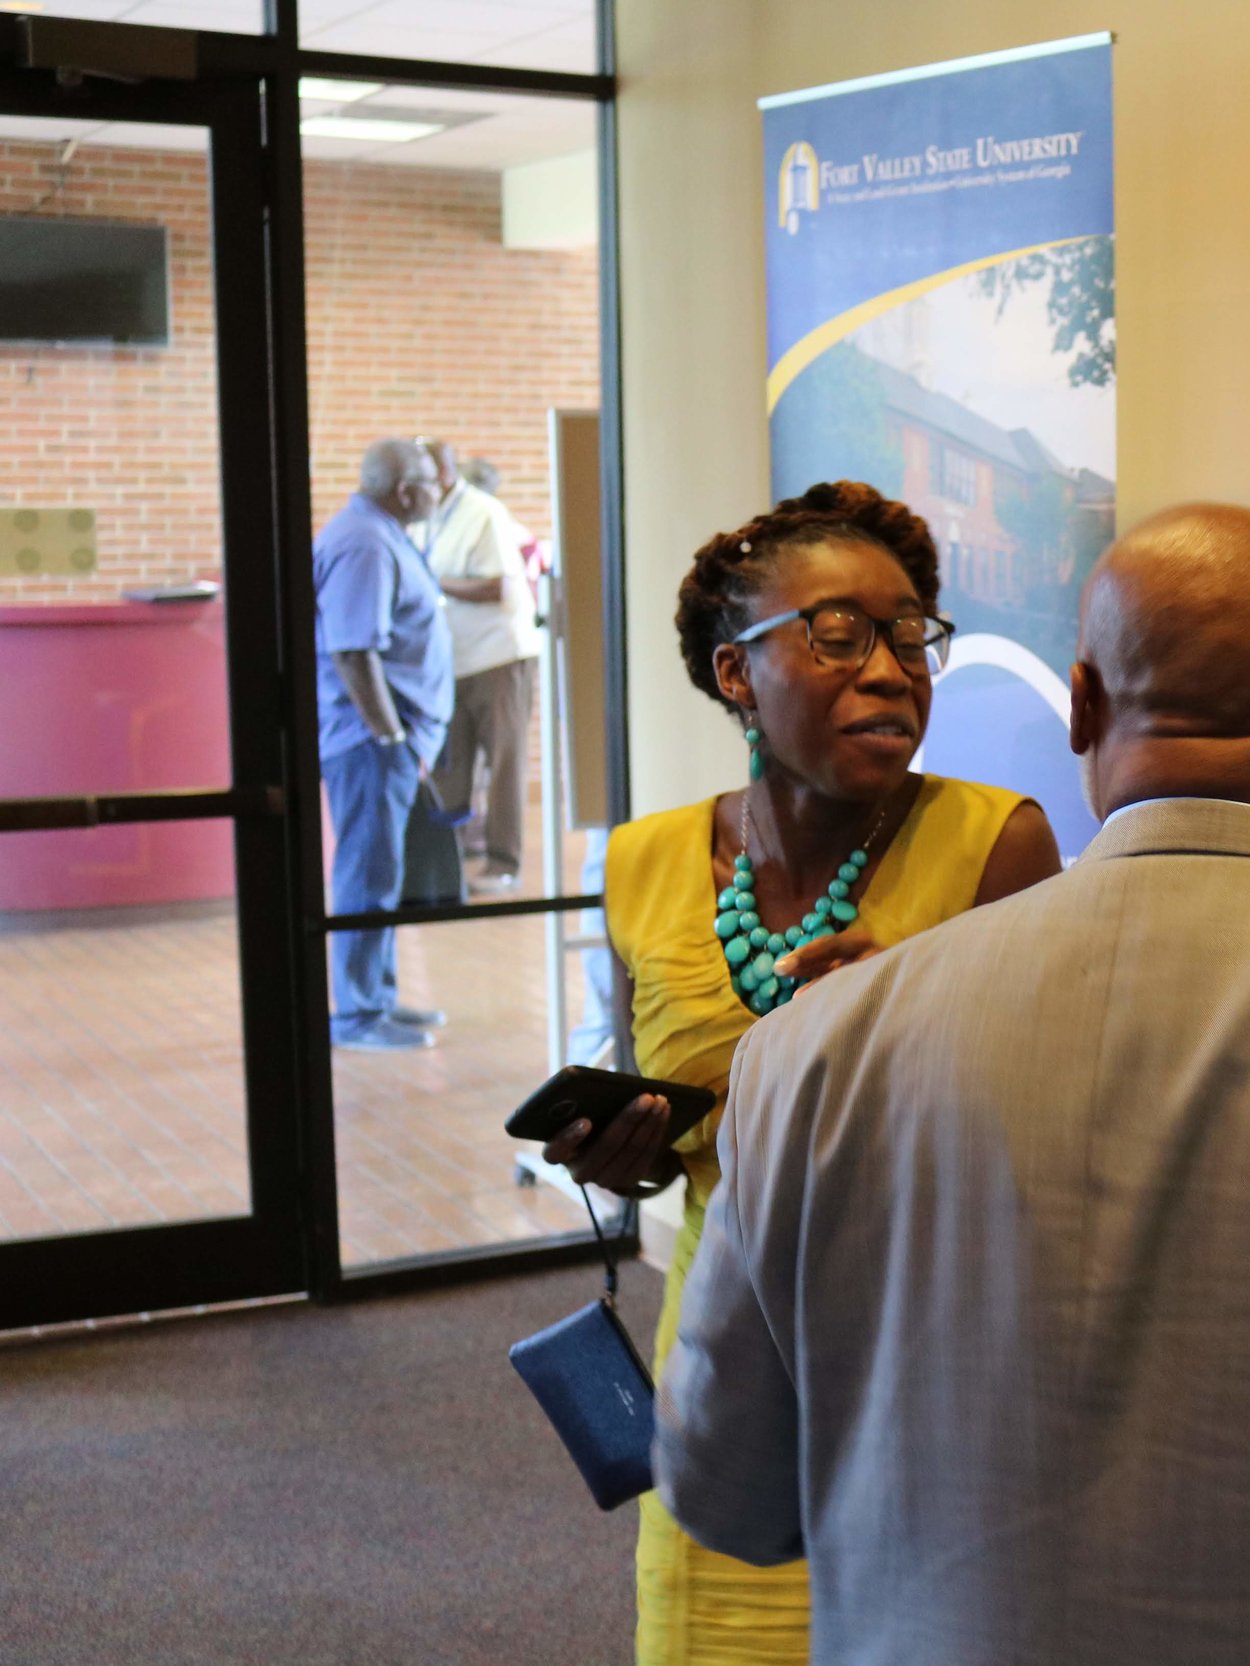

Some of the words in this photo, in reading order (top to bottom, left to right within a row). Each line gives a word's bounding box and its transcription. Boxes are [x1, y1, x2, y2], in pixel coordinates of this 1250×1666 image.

[820, 160, 859, 190] FORT
[862, 153, 922, 183] VALLEY
[925, 145, 973, 174] STATE
[976, 131, 1084, 168] UNIVERSITY
